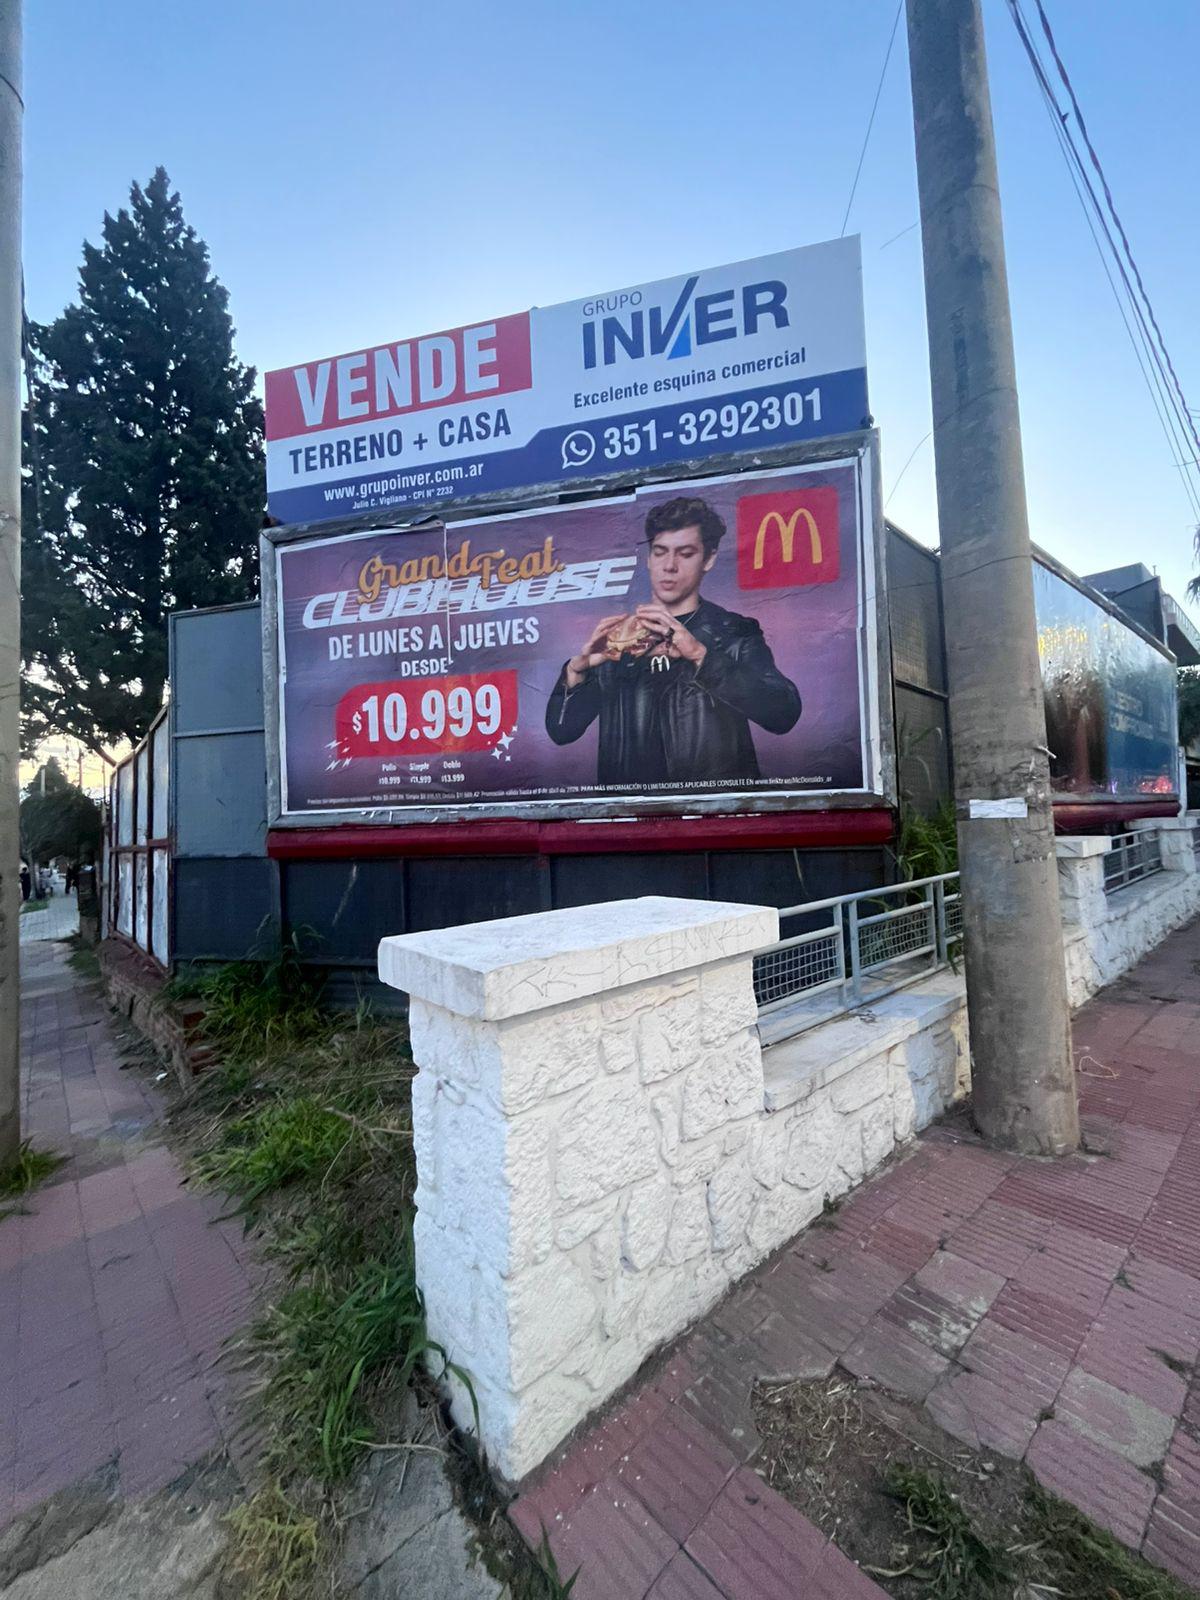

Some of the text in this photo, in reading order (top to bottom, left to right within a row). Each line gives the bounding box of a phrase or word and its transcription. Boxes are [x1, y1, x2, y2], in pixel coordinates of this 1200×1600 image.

[582, 290, 642, 317] GRUPO
[582, 276, 790, 370] INVER
[294, 323, 500, 427] VENDE
[573, 347, 806, 408] Excelente esquina comercial
[289, 429, 403, 475] TERRENO
[438, 408, 511, 447] CASA
[324, 463, 484, 501] www.grupoinver.com.ar
[352, 500, 369, 510] Julio
[379, 493, 407, 506] Vigliano
[413, 491, 425, 500] CPI
[437, 486, 454, 497] 2232
[302, 556, 637, 629] CLUBHOUSE
[358, 540, 471, 604] Grand
[329, 616, 540, 660] DE LUNES A JUEVES
[401, 658, 449, 677] DESDE
[352, 684, 501, 743] $10.999
